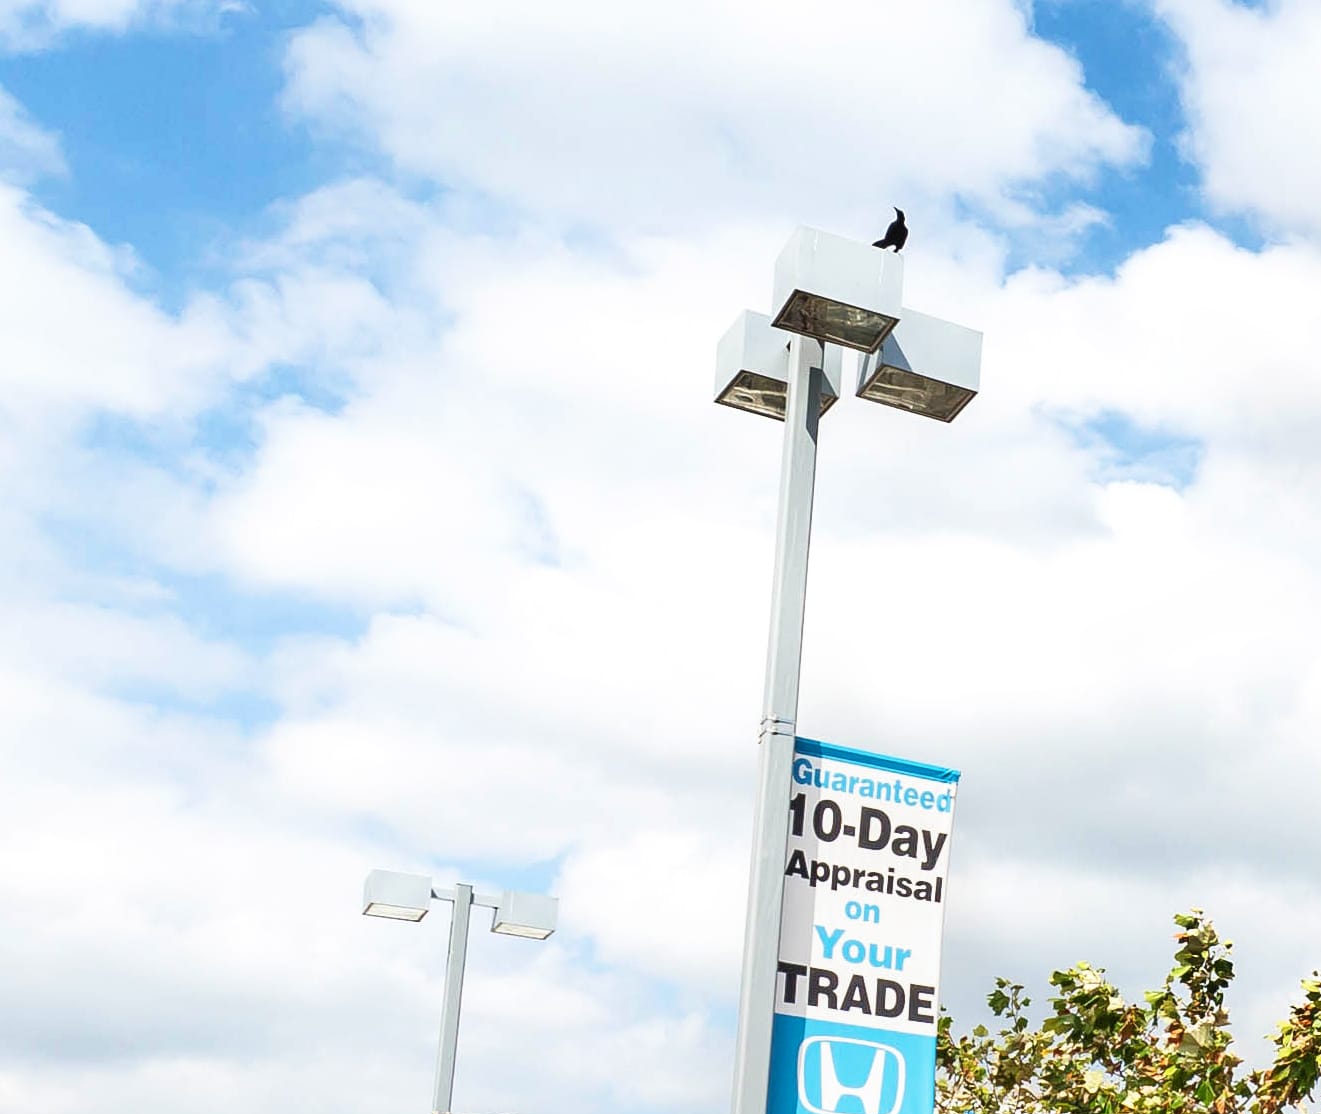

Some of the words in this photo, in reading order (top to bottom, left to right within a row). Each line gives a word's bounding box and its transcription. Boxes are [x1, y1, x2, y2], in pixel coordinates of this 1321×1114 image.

[791, 757, 952, 813] Guaranteed
[789, 792, 948, 871] 10-Day
[784, 849, 943, 904] Appraisal
[844, 899, 880, 924] on
[814, 925, 912, 971] Your
[776, 961, 936, 1025] TRADE
